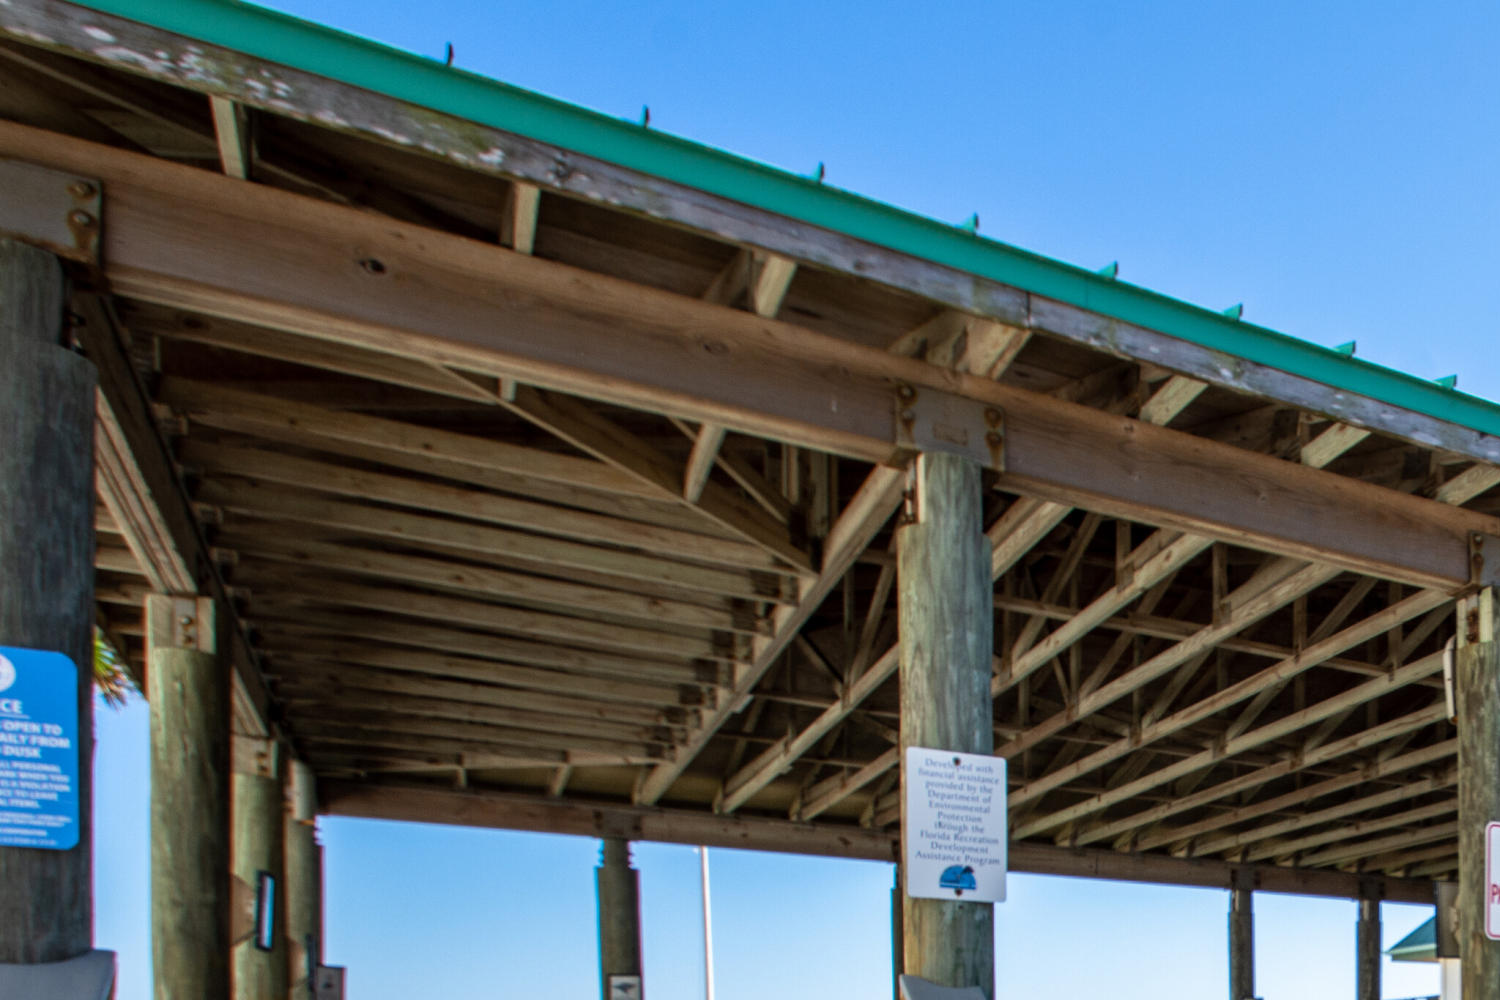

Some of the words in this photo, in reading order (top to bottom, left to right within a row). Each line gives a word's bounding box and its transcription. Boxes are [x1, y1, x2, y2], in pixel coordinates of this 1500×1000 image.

[2, 720, 41, 734] OPEN
[43, 723, 63, 736] TO
[0, 732, 28, 745] AILY
[29, 735, 71, 749] FROM
[2, 745, 42, 759] DUSK
[918, 767, 956, 780] financial
[957, 773, 1000, 785] assistance
[975, 764, 994, 775] with
[925, 780, 964, 792] provided
[967, 783, 977, 794] by
[980, 785, 993, 794] the
[927, 789, 980, 802] Department
[982, 795, 993, 804] of
[928, 799, 991, 814] Environmental
[937, 810, 983, 823] Protection
[920, 829, 951, 841] Florida
[954, 833, 1000, 845] Recreation
[971, 825, 985, 834] the
[930, 840, 990, 856] Development
[915, 850, 962, 863] Assistance
[964, 854, 1001, 868] Program
